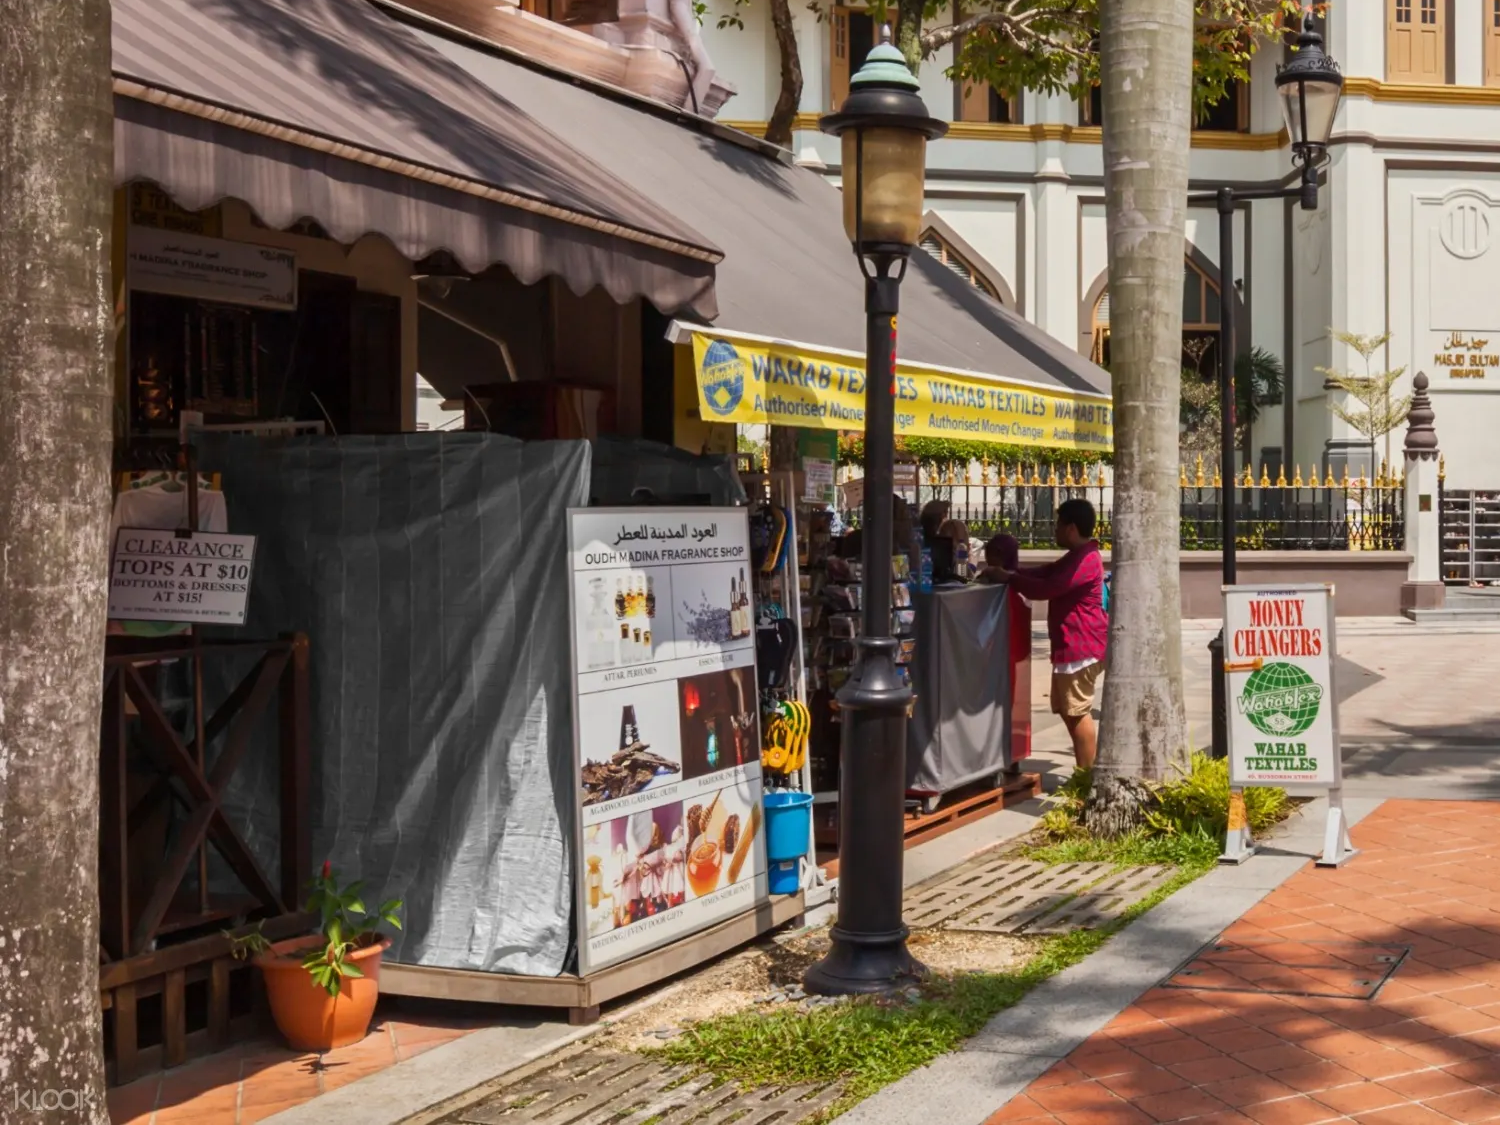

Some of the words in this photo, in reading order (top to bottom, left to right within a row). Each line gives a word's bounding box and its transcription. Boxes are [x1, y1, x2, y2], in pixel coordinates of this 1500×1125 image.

[1470, 354, 1499, 367] SULTAN
[751, 355, 831, 389] WAHAB
[928, 380, 985, 409] WAHAB
[989, 390, 1046, 416] TEXTILES
[1055, 401, 1094, 423] WAHAB
[754, 394, 826, 417] Authorised
[830, 403, 866, 421] Mone
[928, 413, 979, 432] Authorised
[982, 419, 1010, 438] Money
[1011, 422, 1044, 440] Changer
[613, 524, 648, 545] للعطر
[650, 524, 688, 542] المدينة
[692, 523, 717, 542] العود
[125, 538, 245, 559] CLEARANCE
[585, 552, 617, 565] OUDH
[619, 550, 659, 563] MADINA
[661, 547, 718, 560] FRAGRANCE
[720, 546, 744, 557] SHOP
[116, 559, 174, 576] TOPS
[179, 563, 212, 578] AT
[217, 564, 248, 580] $10
[113, 578, 175, 590] BOTTOMS
[178, 581, 187, 590] &
[191, 582, 246, 592] DRESSES
[153, 591, 174, 602] AT
[178, 592, 202, 604] $15!
[1249, 599, 1304, 627] MONEY
[1234, 628, 1321, 656] CHANGERS
[1254, 743, 1307, 756] WAHAB
[1245, 757, 1318, 771] TEXTILES
